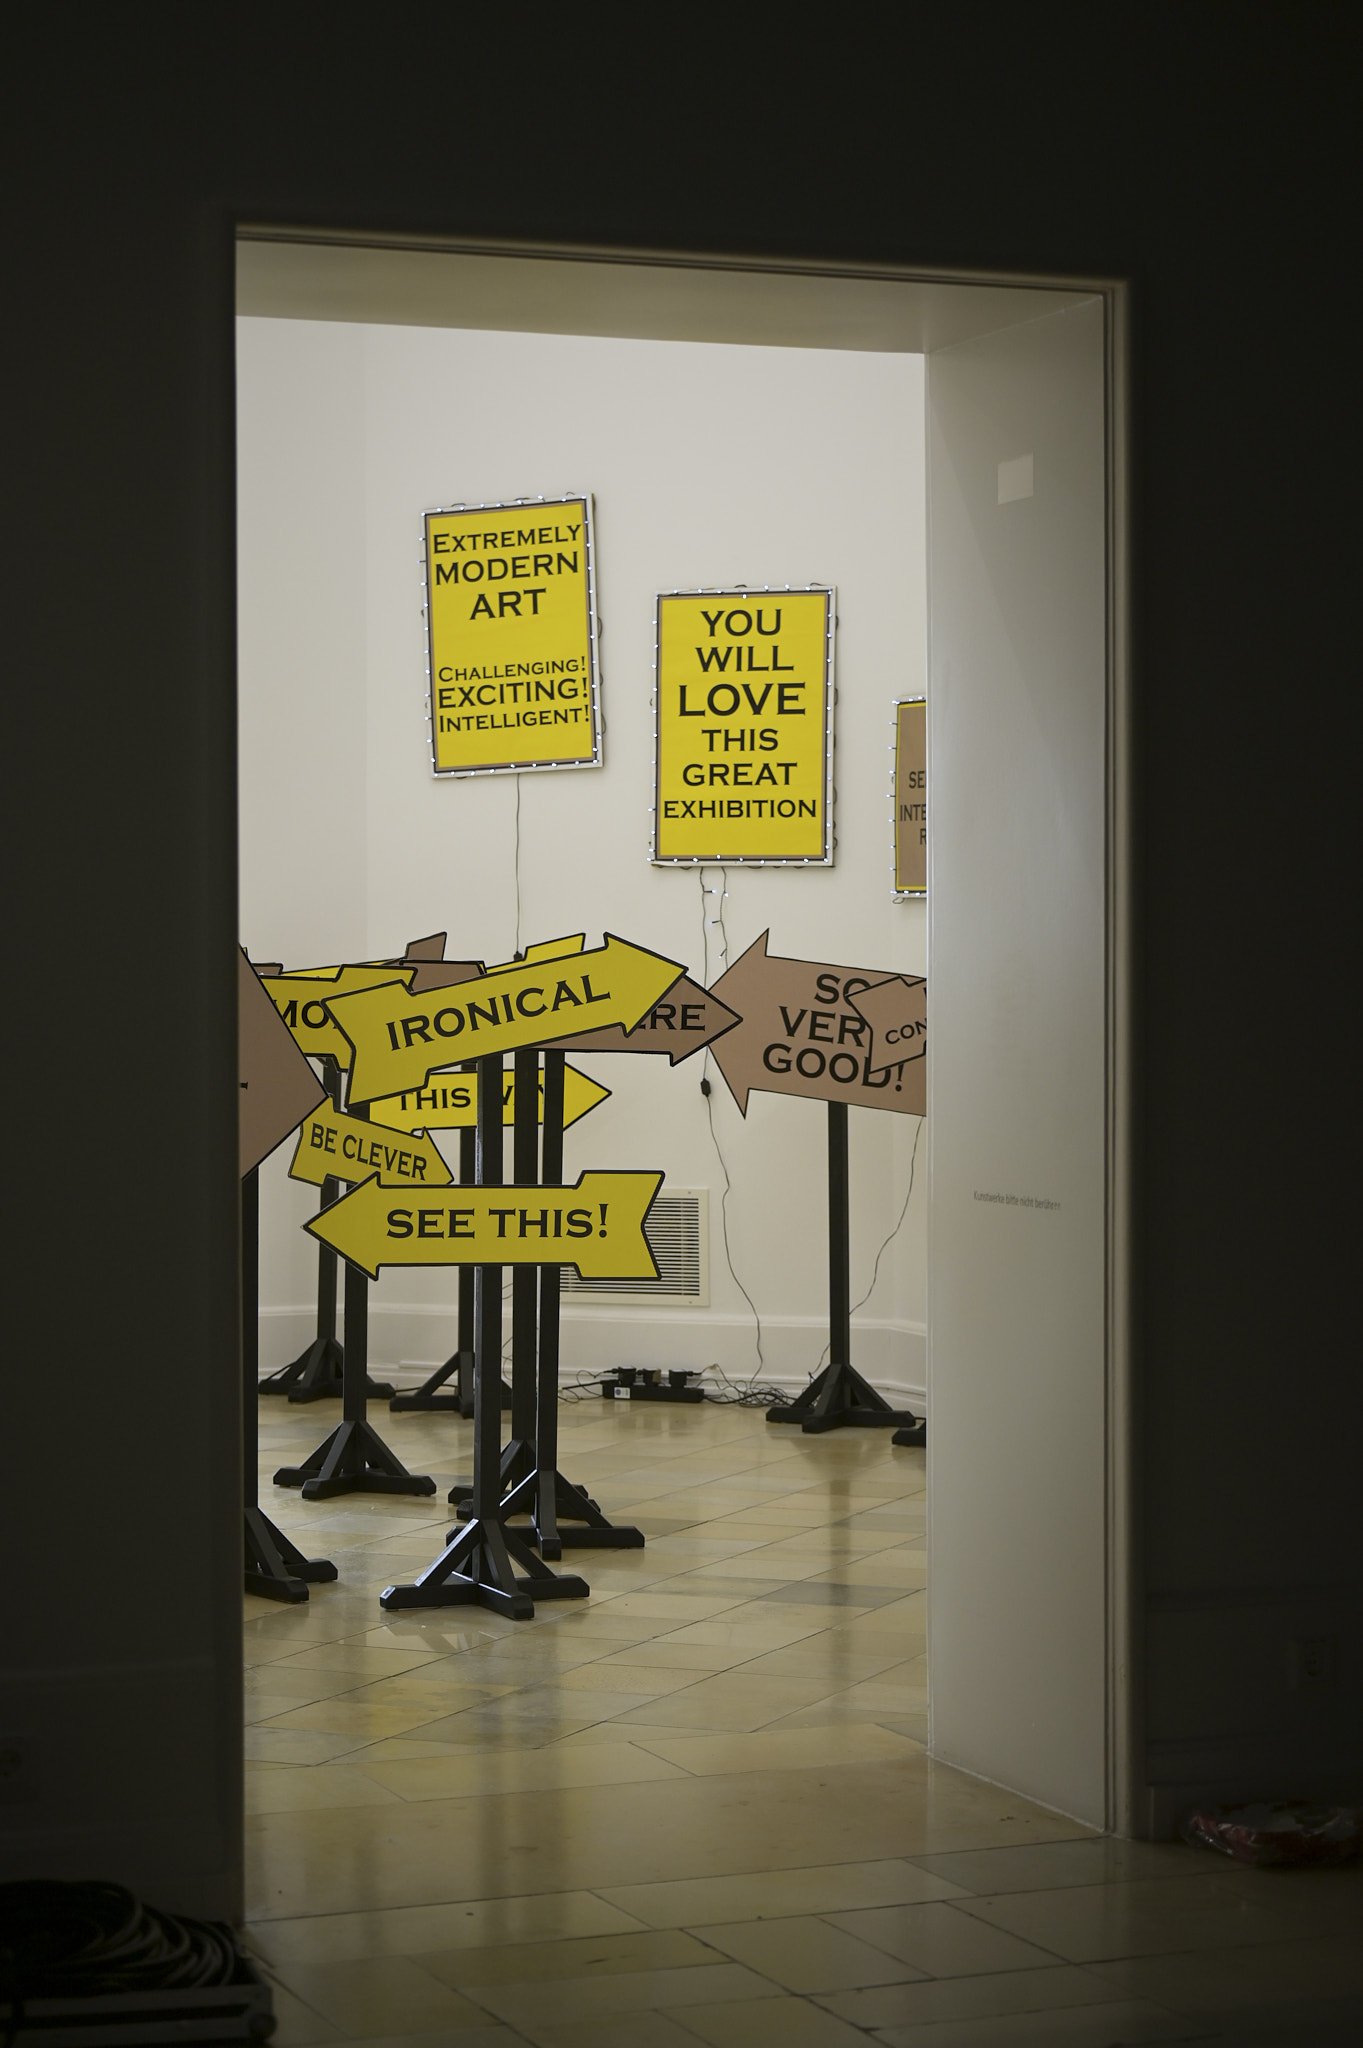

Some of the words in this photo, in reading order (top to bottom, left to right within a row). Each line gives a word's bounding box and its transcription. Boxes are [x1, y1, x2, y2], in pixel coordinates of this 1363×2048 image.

[433, 524, 581, 554] EXTREMELY
[435, 551, 579, 586] MODERN
[469, 588, 547, 621] ART
[701, 609, 782, 637] YOU
[438, 656, 586, 683] CHALLENGING!
[696, 646, 794, 673] WILL
[438, 676, 588, 709] EXCITING!
[679, 682, 806, 717] LOVE
[439, 704, 590, 733] INTELLIGENT!
[702, 729, 779, 752] THIS
[682, 762, 798, 787] GREAT
[908, 770, 926, 789] SE
[664, 799, 817, 819] EXHIBITION
[272, 999, 338, 1030] MO
[386, 973, 611, 1052] IRONICAL
[638, 1003, 706, 1032] RE
[762, 1042, 905, 1092] GOOD!
[400, 1086, 471, 1111] THIS
[310, 1122, 338, 1155] BE
[342, 1133, 428, 1182] CLEVER
[1005, 1193, 1019, 1206] bitte
[1020, 1195, 1034, 1208] nicht
[386, 1208, 475, 1239] SEE
[488, 1203, 609, 1239] THIS!
